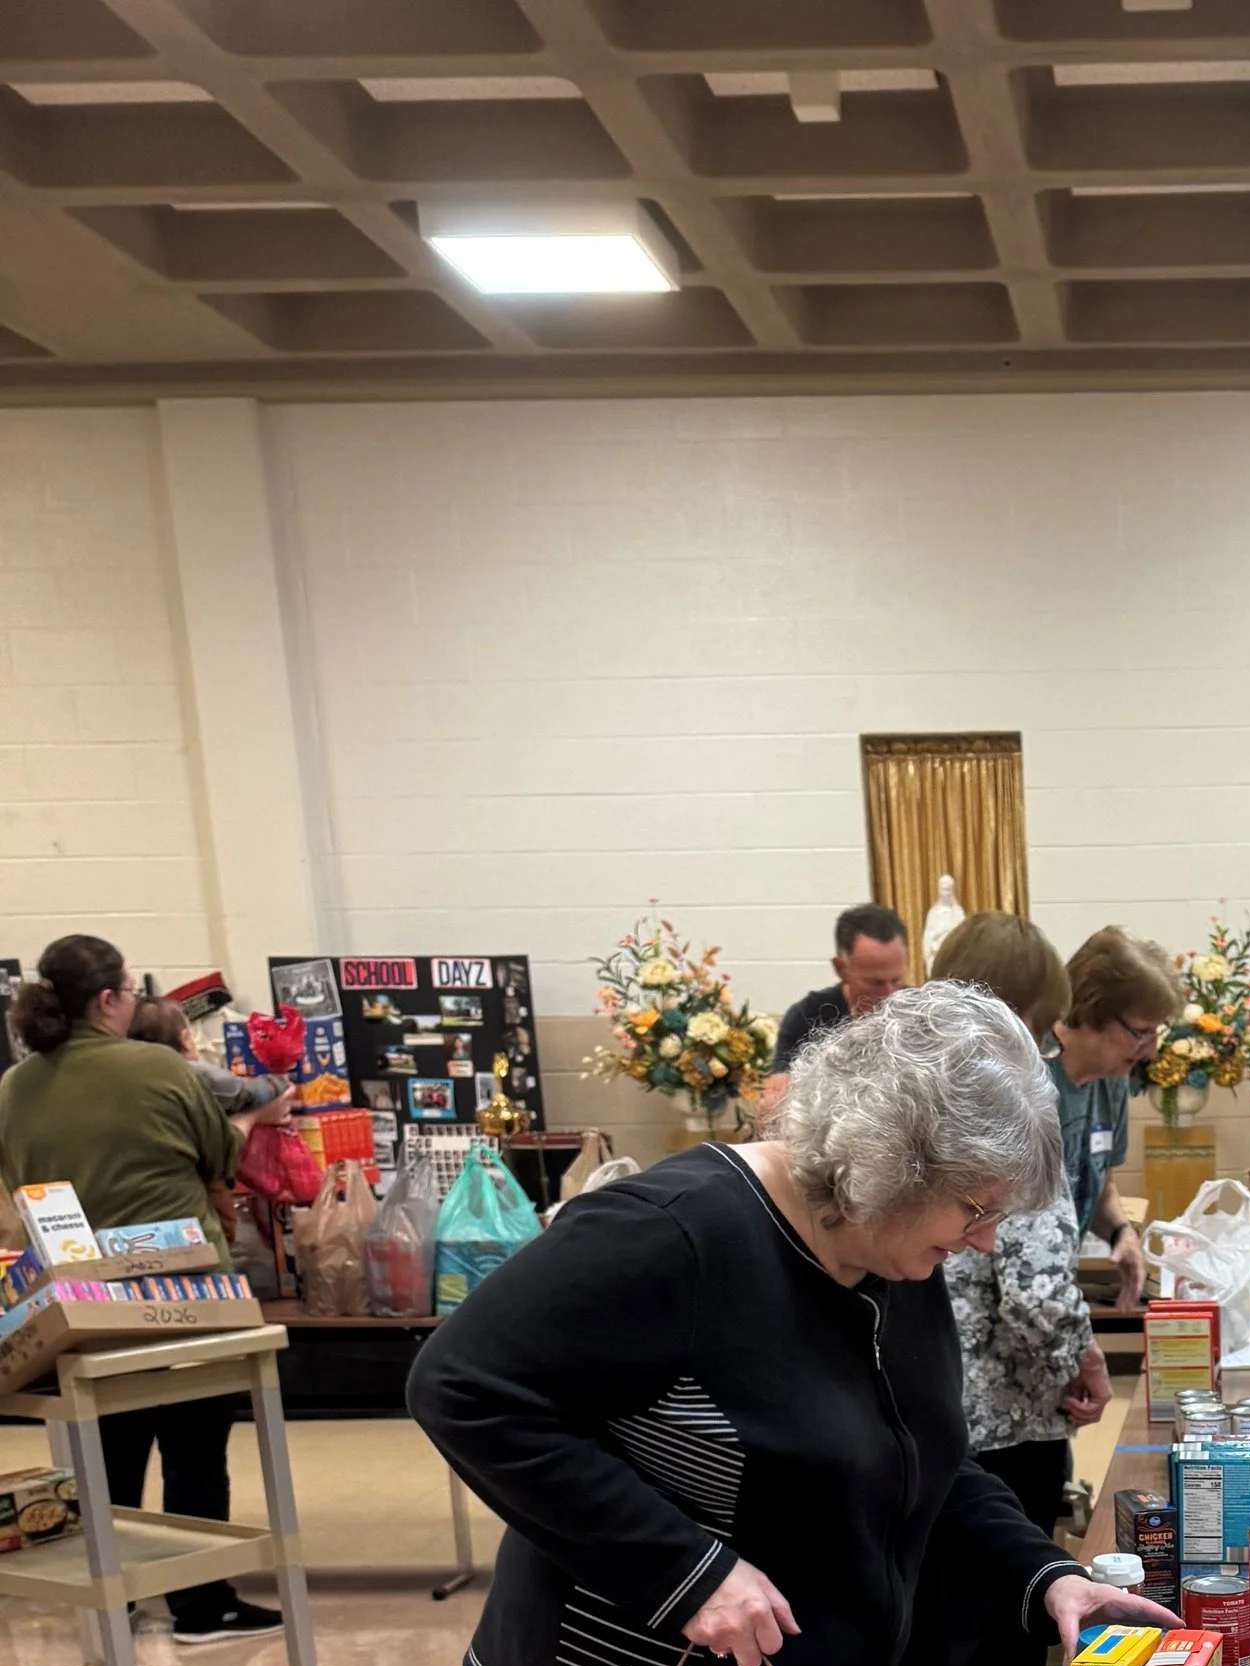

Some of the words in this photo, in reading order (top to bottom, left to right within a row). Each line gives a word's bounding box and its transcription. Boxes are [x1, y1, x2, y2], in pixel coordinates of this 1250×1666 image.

[344, 961, 414, 986] SCHOOL
[438, 961, 487, 986] DAYZ
[143, 1305, 197, 1324] 2026
[1139, 1532, 1173, 1541] CHICKEN
